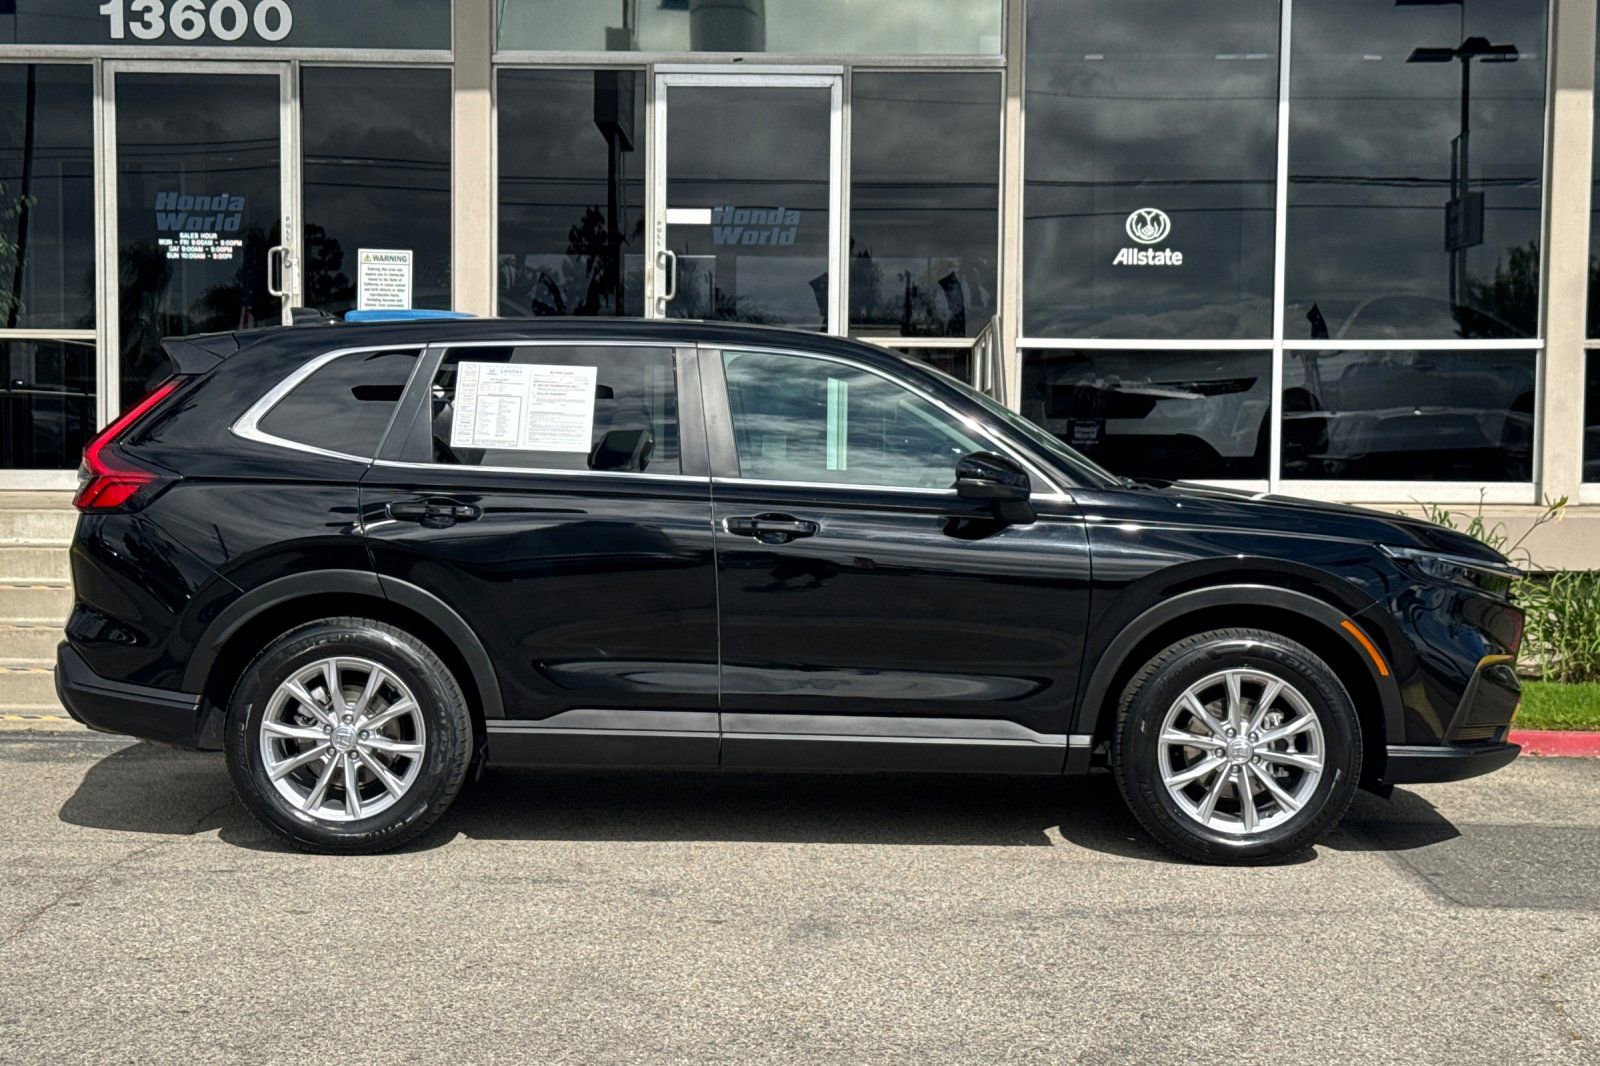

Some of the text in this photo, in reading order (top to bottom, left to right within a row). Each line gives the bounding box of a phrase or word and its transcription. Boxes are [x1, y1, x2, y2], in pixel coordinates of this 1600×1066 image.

[100, 0, 293, 41] 13600
[155, 192, 245, 211] Honda
[156, 212, 242, 231] World
[712, 206, 800, 225] Honda
[713, 226, 797, 245] World
[372, 254, 408, 263] WARNING
[1112, 248, 1183, 265] Allstate
